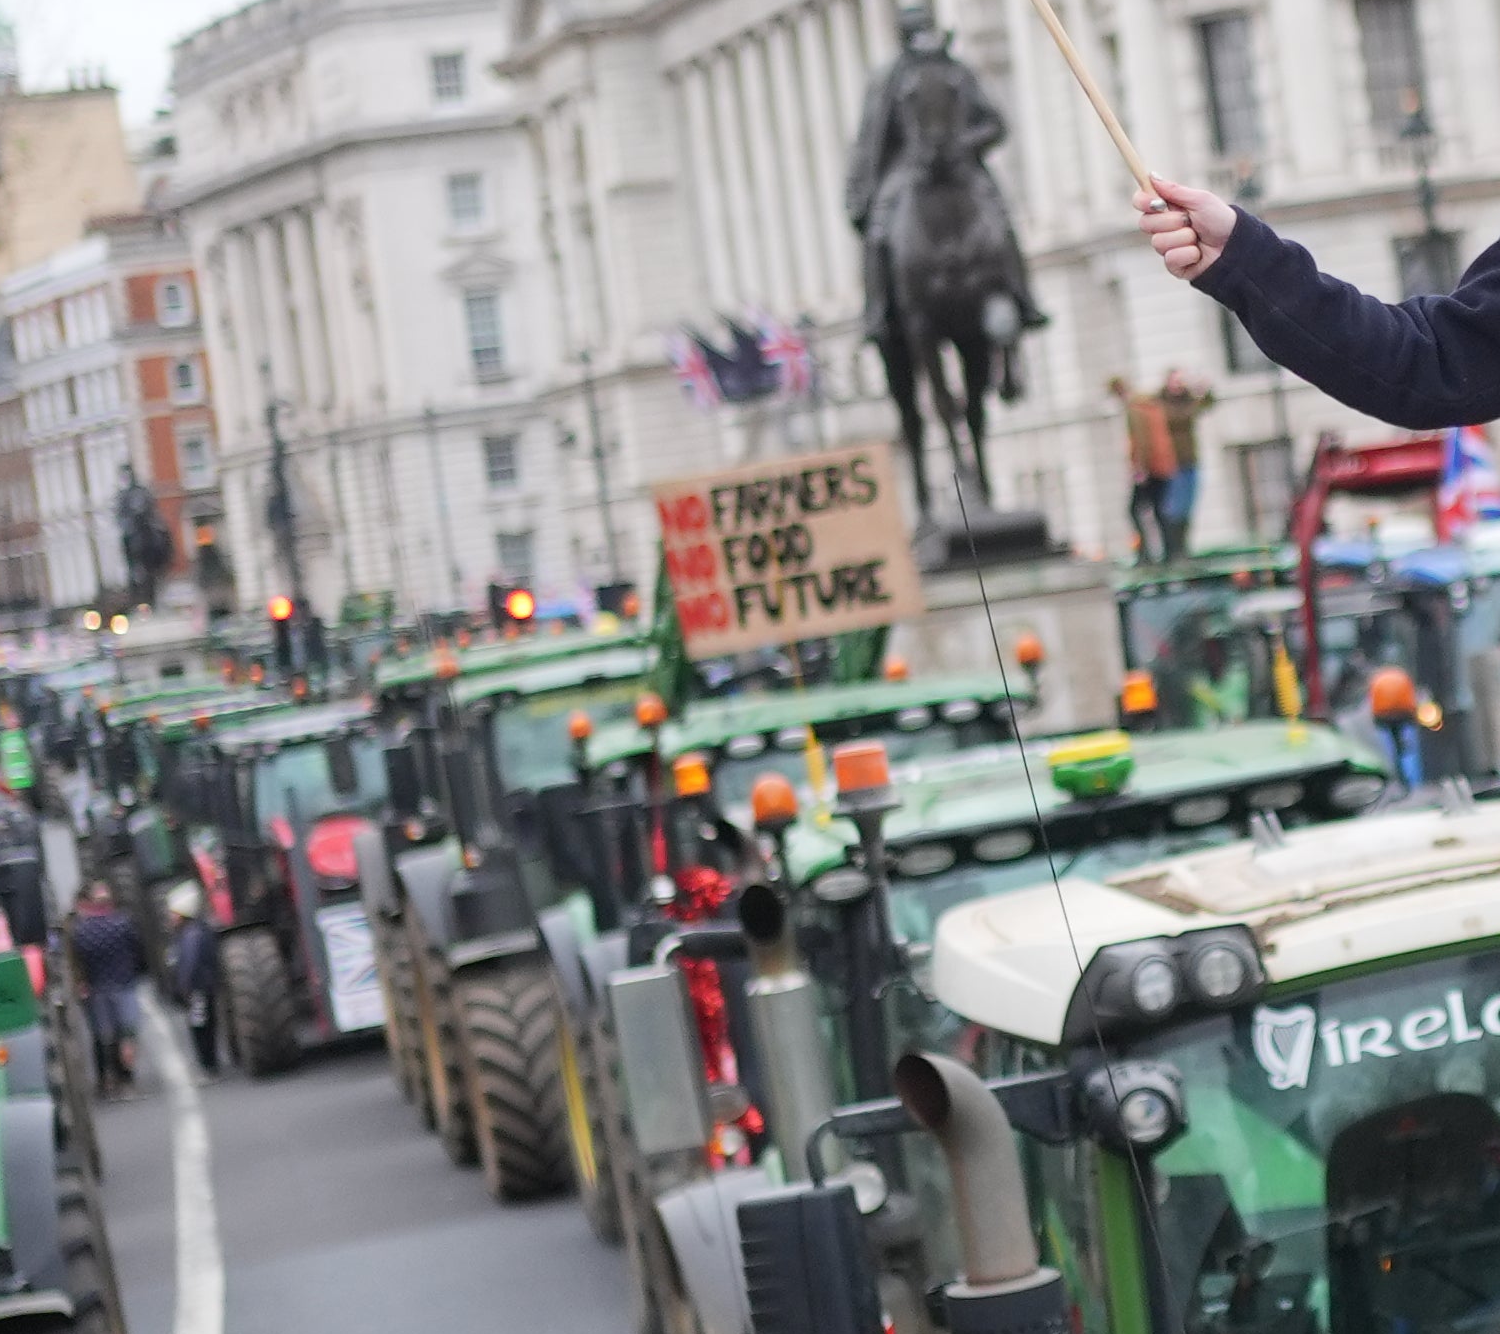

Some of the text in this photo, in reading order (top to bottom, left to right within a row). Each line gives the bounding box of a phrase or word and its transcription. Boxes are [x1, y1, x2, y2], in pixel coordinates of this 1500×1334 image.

[656, 457, 878, 533] NO FARMERS
[664, 523, 813, 584] NO FOOD
[675, 559, 891, 639] NO FUTURE
